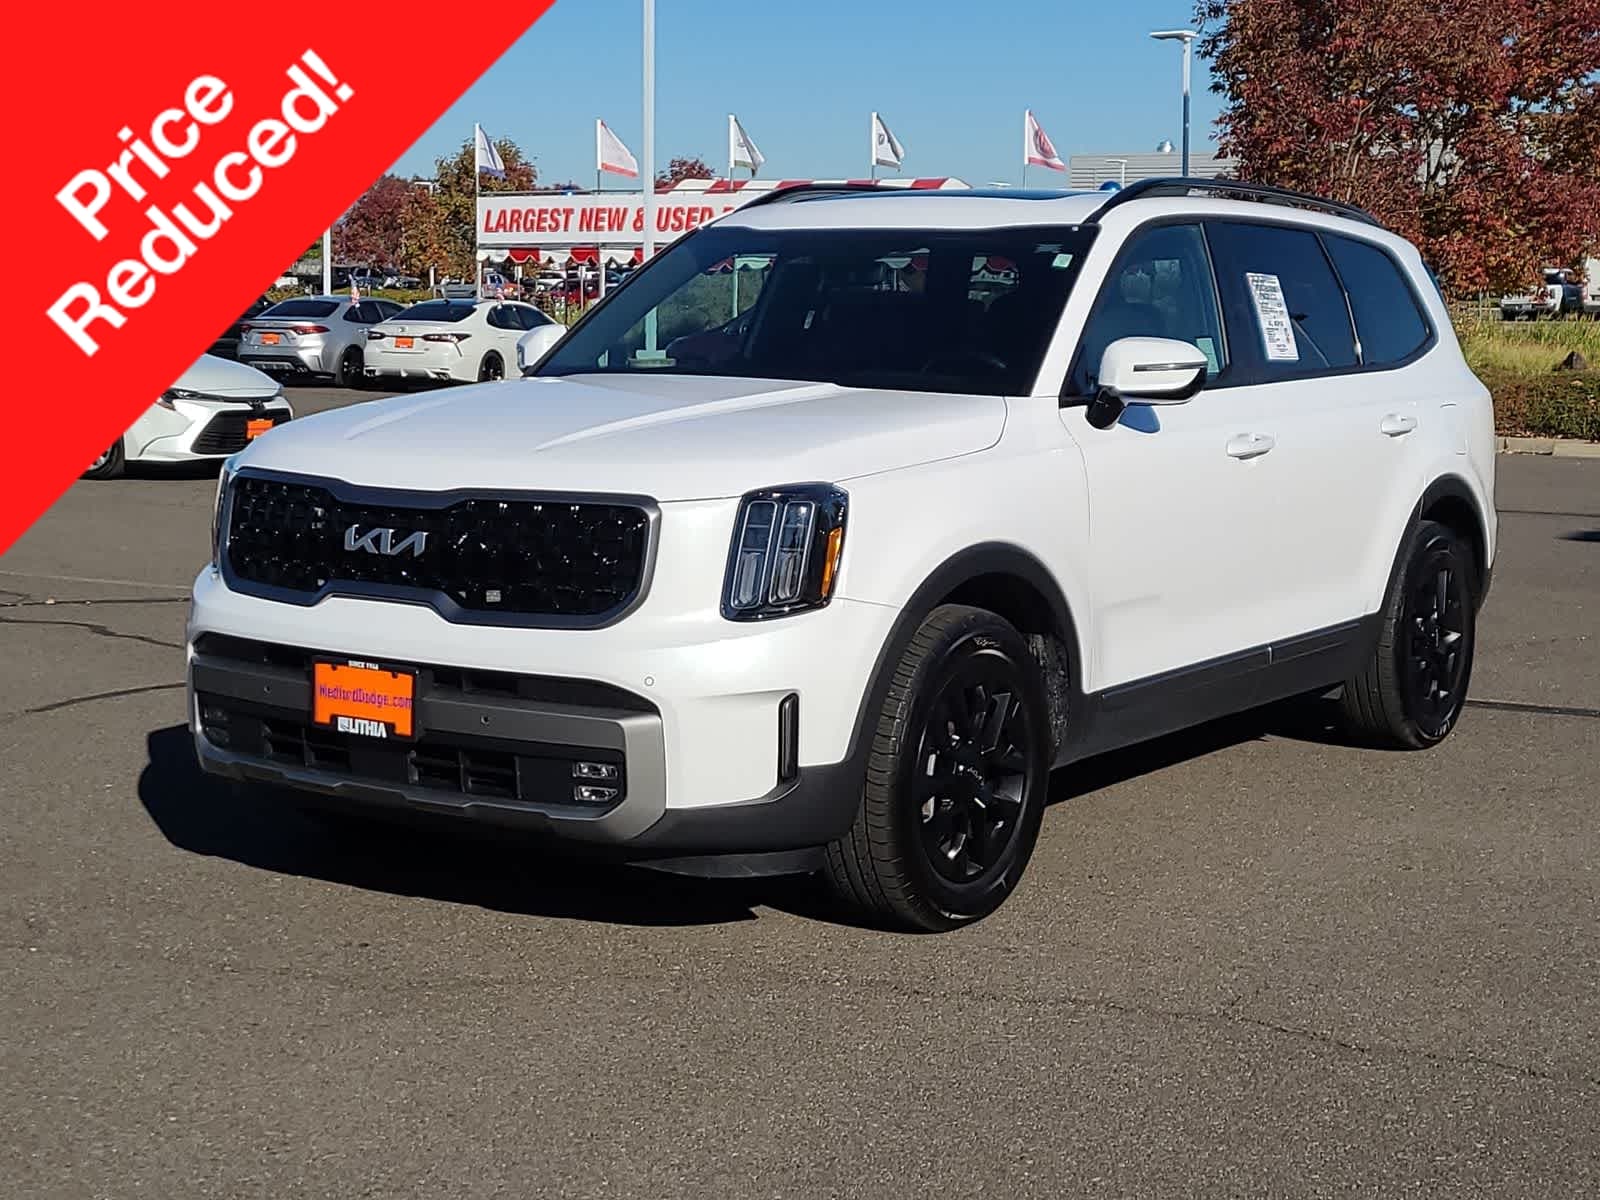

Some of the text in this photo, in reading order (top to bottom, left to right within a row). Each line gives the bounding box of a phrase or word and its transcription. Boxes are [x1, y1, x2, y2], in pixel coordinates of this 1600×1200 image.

[484, 207, 714, 233] LARGEST NEW & USED
